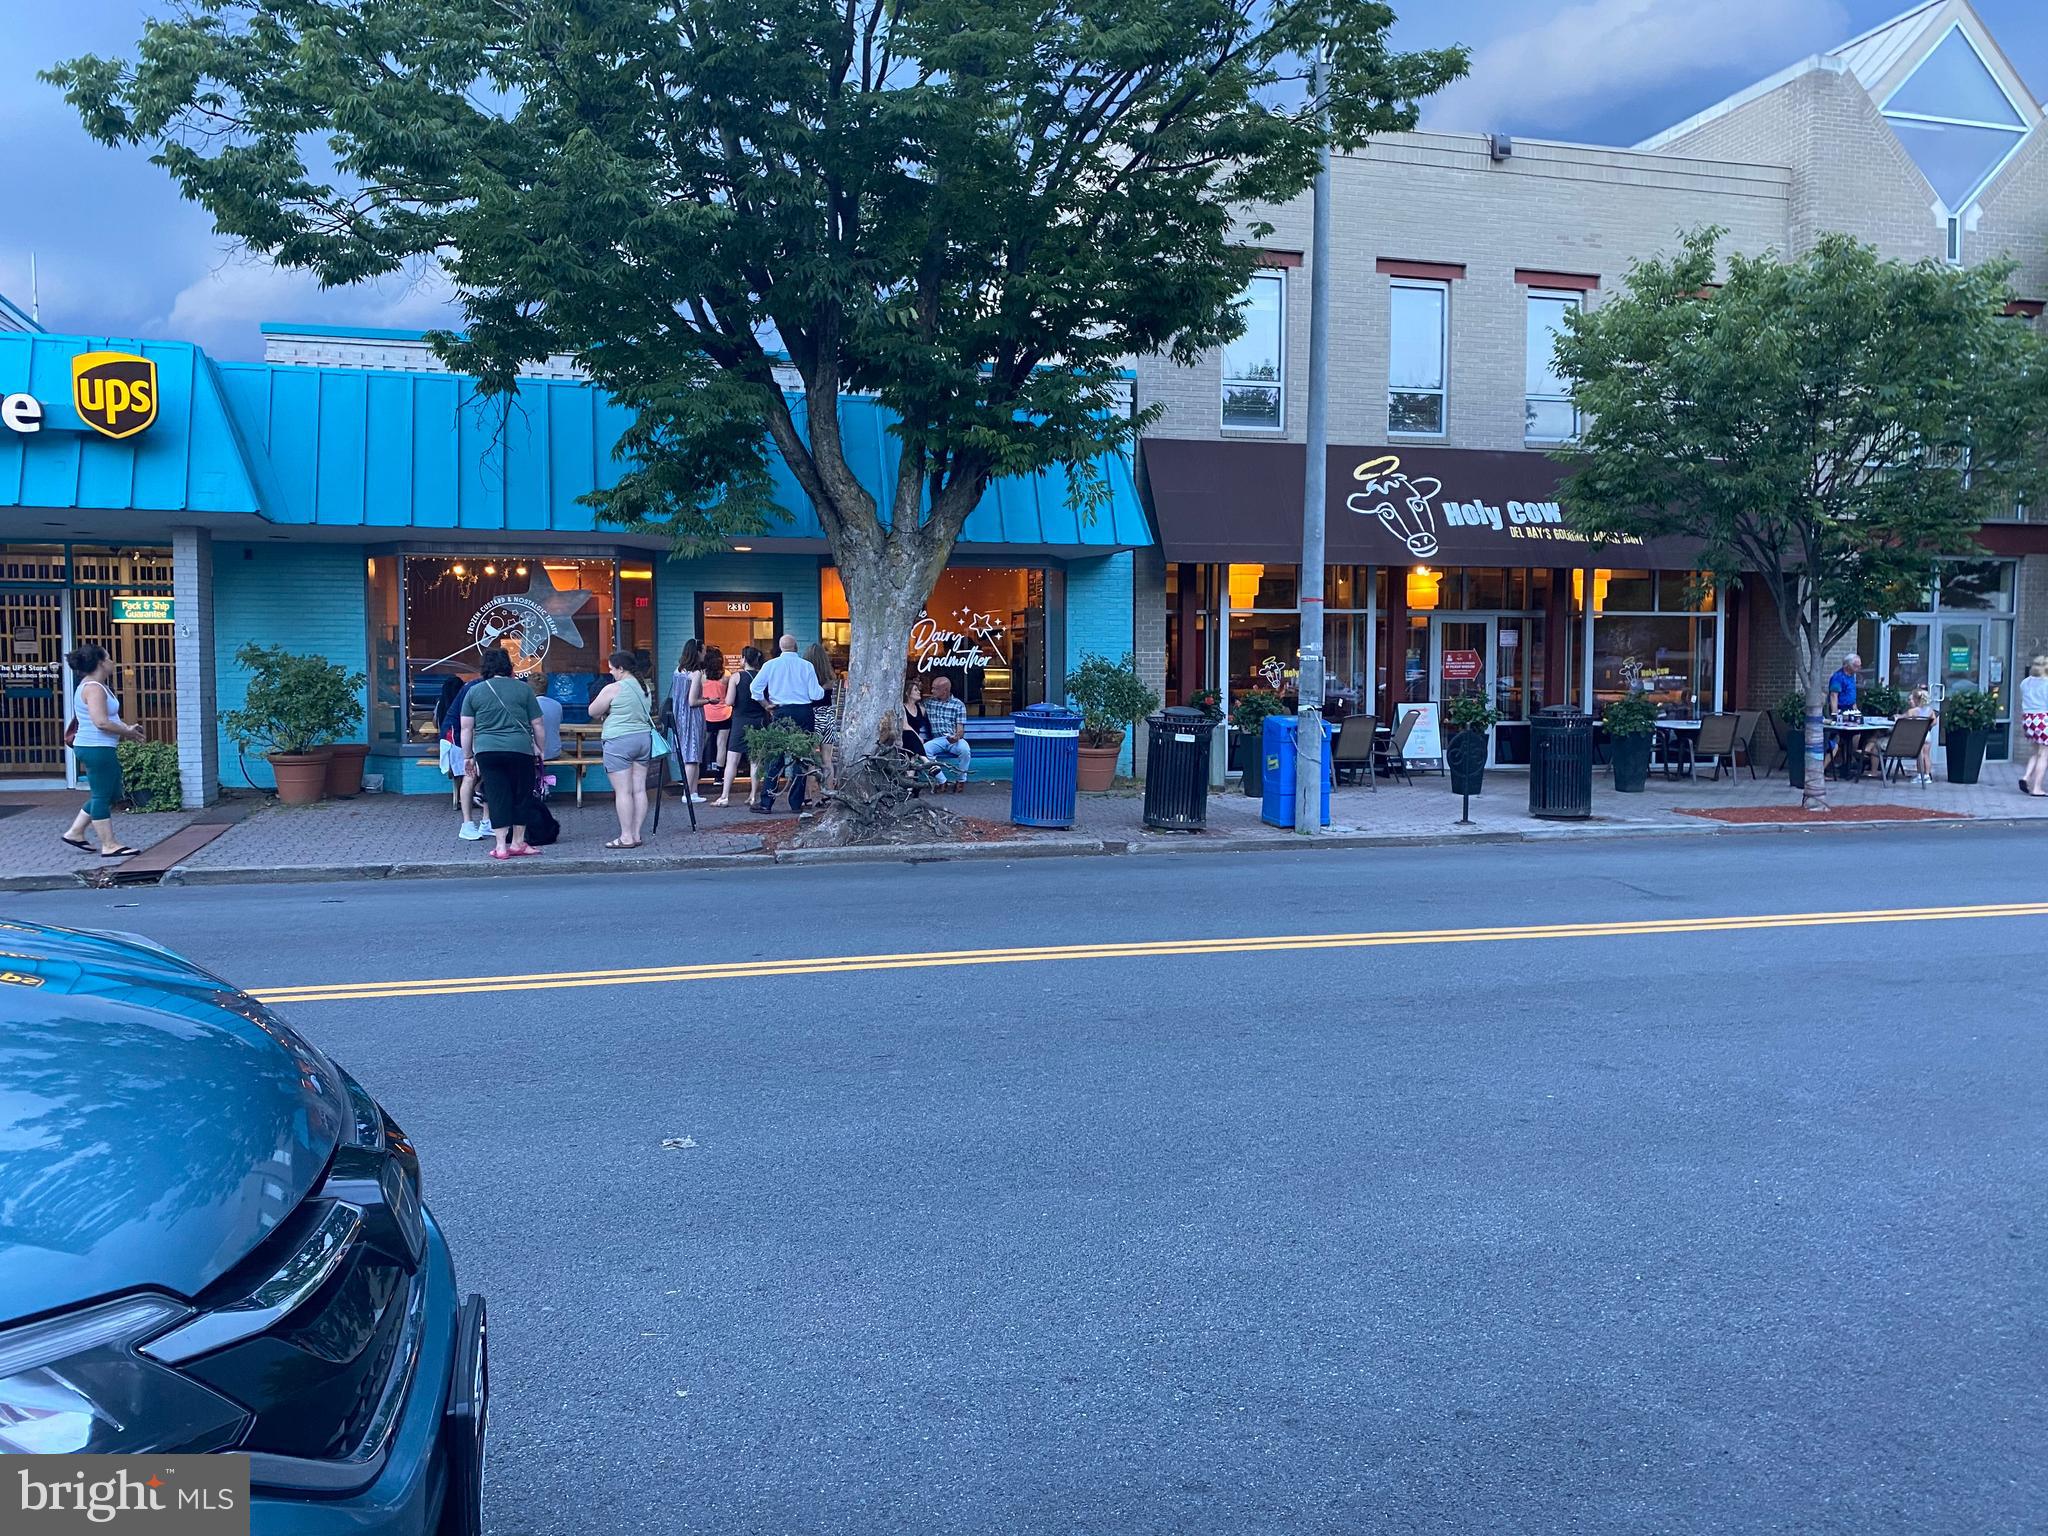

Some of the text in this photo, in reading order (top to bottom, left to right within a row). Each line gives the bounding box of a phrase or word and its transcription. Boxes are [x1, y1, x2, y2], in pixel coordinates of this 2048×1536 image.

[1441, 499, 1504, 530] Holy
[1509, 525, 1524, 538] DEL
[1525, 526, 1552, 540] RAY'S
[122, 601, 142, 610] Pack
[152, 601, 170, 612] Ship
[480, 597, 506, 615] CUSTARD
[513, 596, 547, 616] NOSTALGIC
[635, 597, 649, 607] EXIT
[728, 603, 751, 611] 2310
[125, 610, 167, 619] Guarantee
[910, 618, 965, 652] Dairy
[917, 645, 992, 674] Godmother
